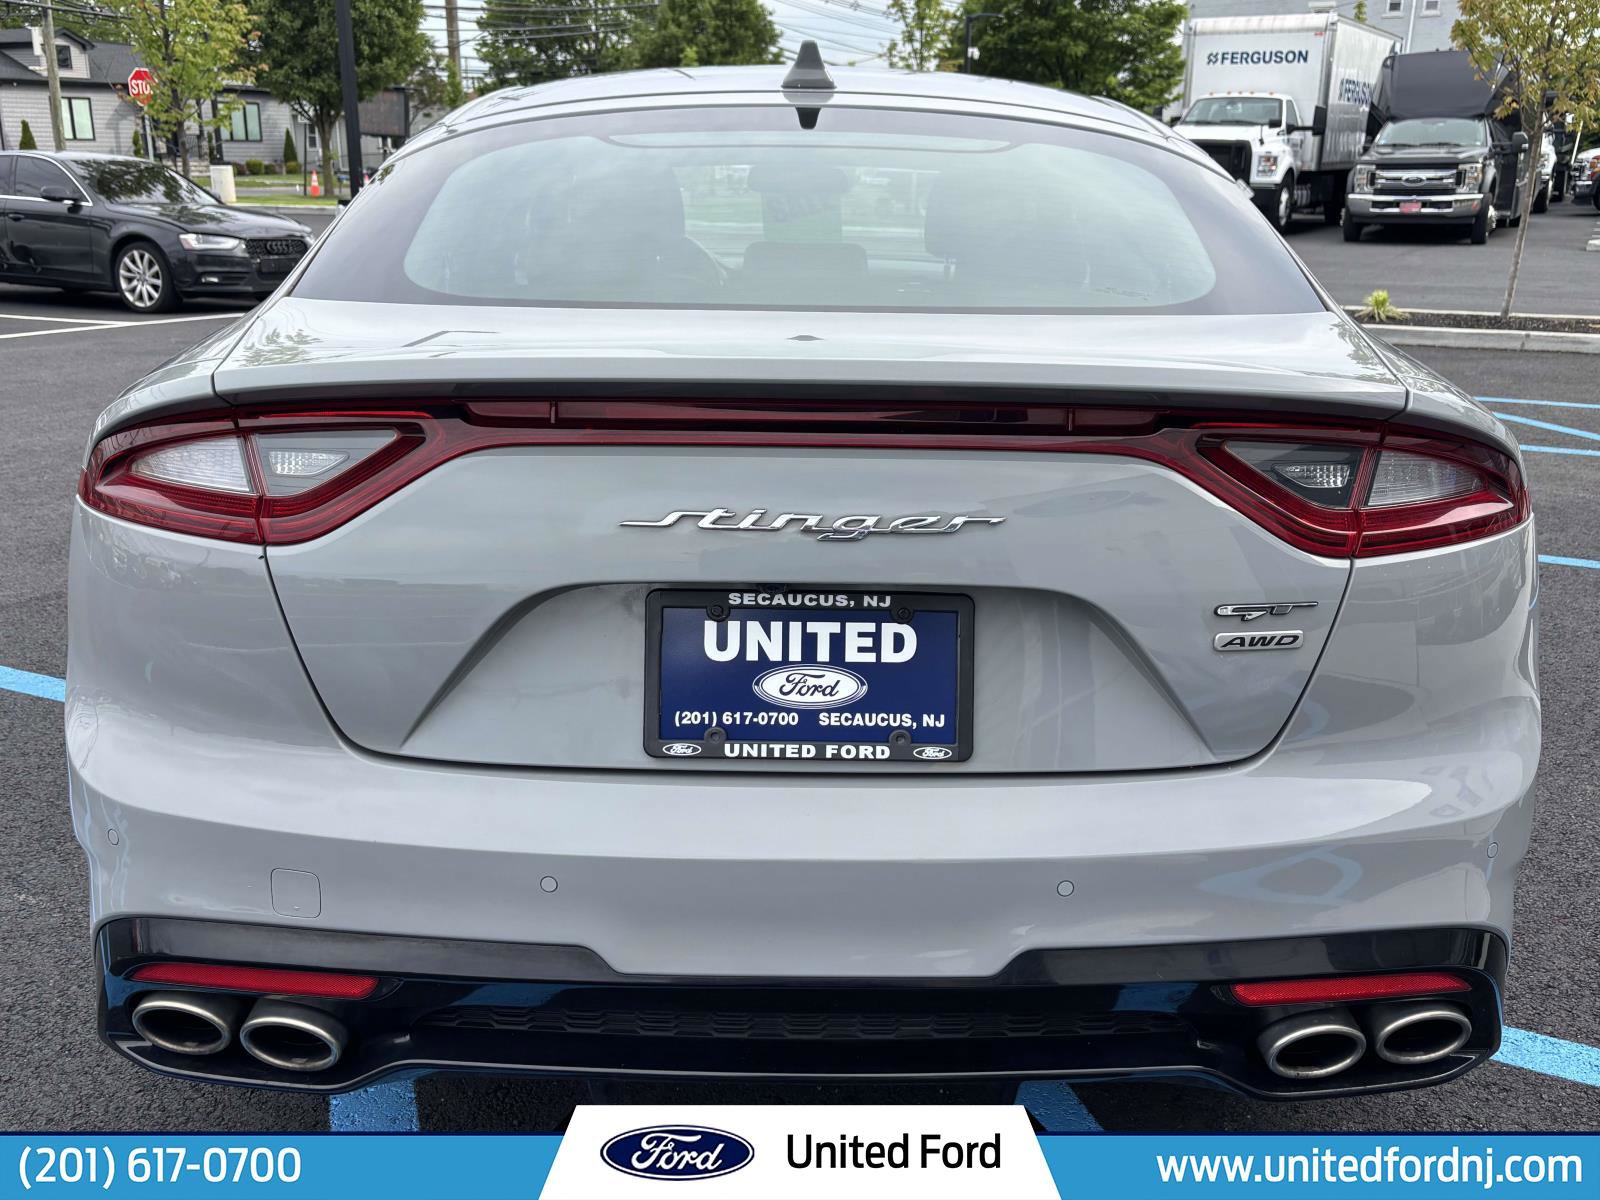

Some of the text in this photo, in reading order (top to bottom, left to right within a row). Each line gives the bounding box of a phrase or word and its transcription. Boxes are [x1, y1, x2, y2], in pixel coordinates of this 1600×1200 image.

[1220, 50, 1309, 65] FERGUSON
[131, 79, 154, 95] STO
[728, 592, 891, 608] SECAUCUS, NJ
[703, 620, 918, 663] UNITED
[1219, 635, 1300, 648] AWD
[779, 672, 841, 697] Ford
[674, 710, 799, 727] (201) 617-0700
[818, 712, 945, 730] SECAUCUS, NJ
[669, 744, 693, 754] Ford
[724, 743, 891, 760] UNITED FORD
[922, 747, 946, 758] Ford
